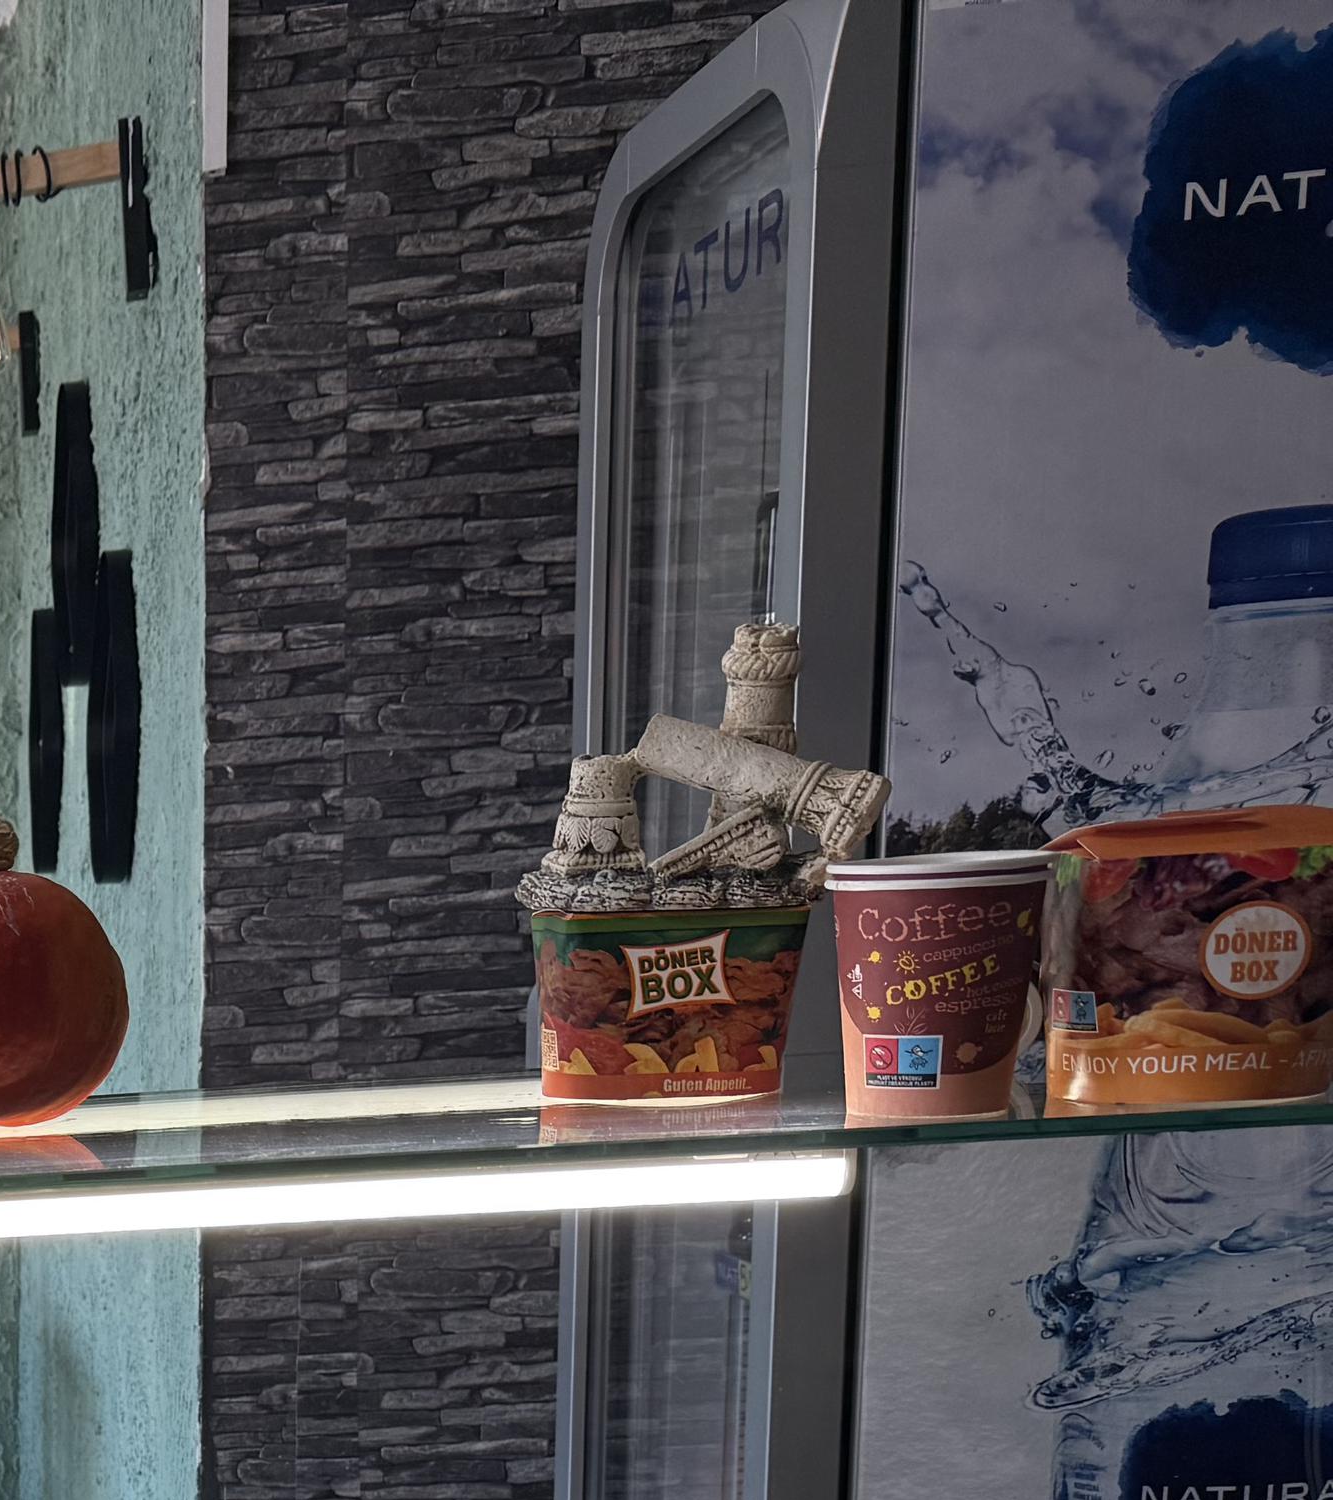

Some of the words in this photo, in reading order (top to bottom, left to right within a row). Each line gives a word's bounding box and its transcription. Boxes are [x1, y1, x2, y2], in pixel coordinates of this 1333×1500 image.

[1184, 168, 1326, 221] NAT
[858, 901, 1012, 942] Coffee
[1213, 928, 1298, 955] DÖNER
[638, 946, 717, 975] DÖNER
[1230, 959, 1279, 983] BOX
[640, 964, 721, 1004] BOX
[885, 954, 1001, 1006] COFFEE
[1062, 1052, 1118, 1074] ENJOY
[1126, 1054, 1196, 1074] YOUR
[1205, 1051, 1272, 1071] MEAL
[663, 1078, 702, 1092] Guten
